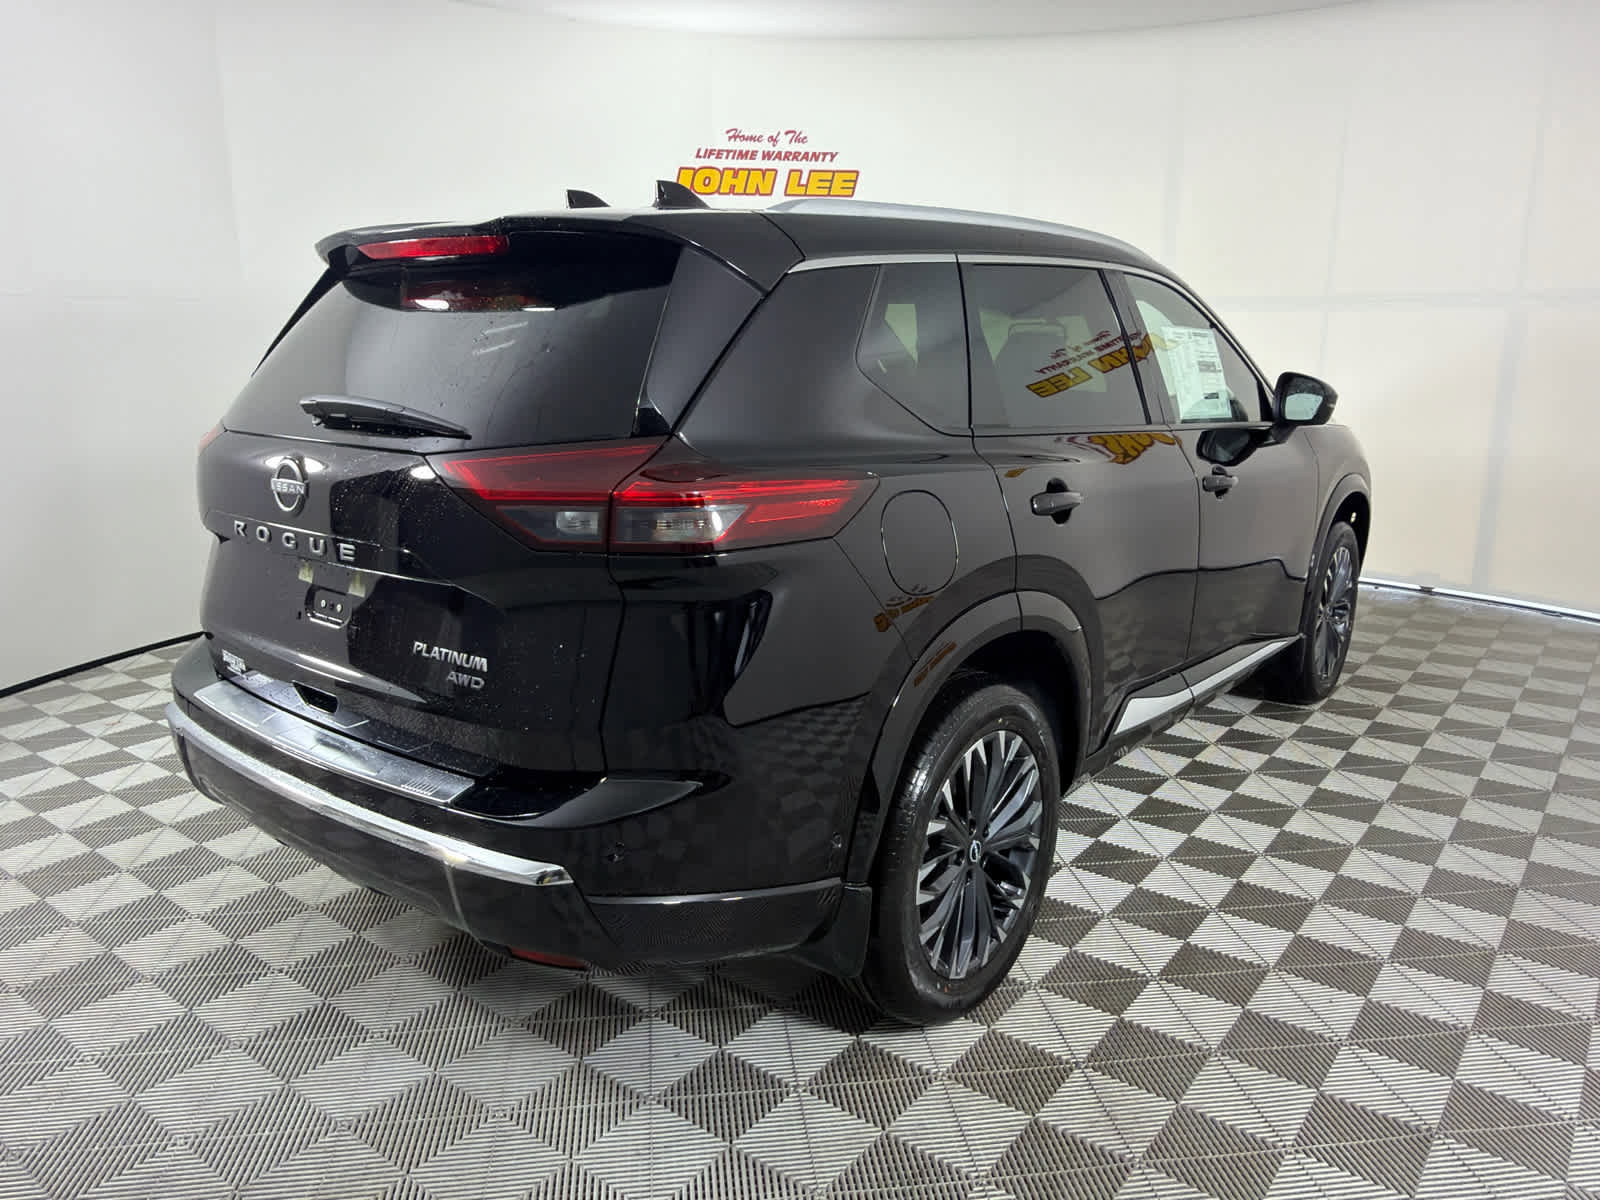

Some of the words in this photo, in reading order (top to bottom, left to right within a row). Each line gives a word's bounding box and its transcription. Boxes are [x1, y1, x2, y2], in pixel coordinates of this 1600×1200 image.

[726, 128, 763, 144] Home
[767, 131, 780, 147] of
[784, 130, 808, 145] The
[695, 148, 758, 161] LIFETIME
[761, 150, 838, 163] WARRANTY
[784, 169, 859, 198] LEE
[271, 480, 305, 495] SSAN
[233, 520, 357, 562] ROGUE
[412, 641, 488, 672] PLATINUM
[446, 671, 485, 689] AWD
